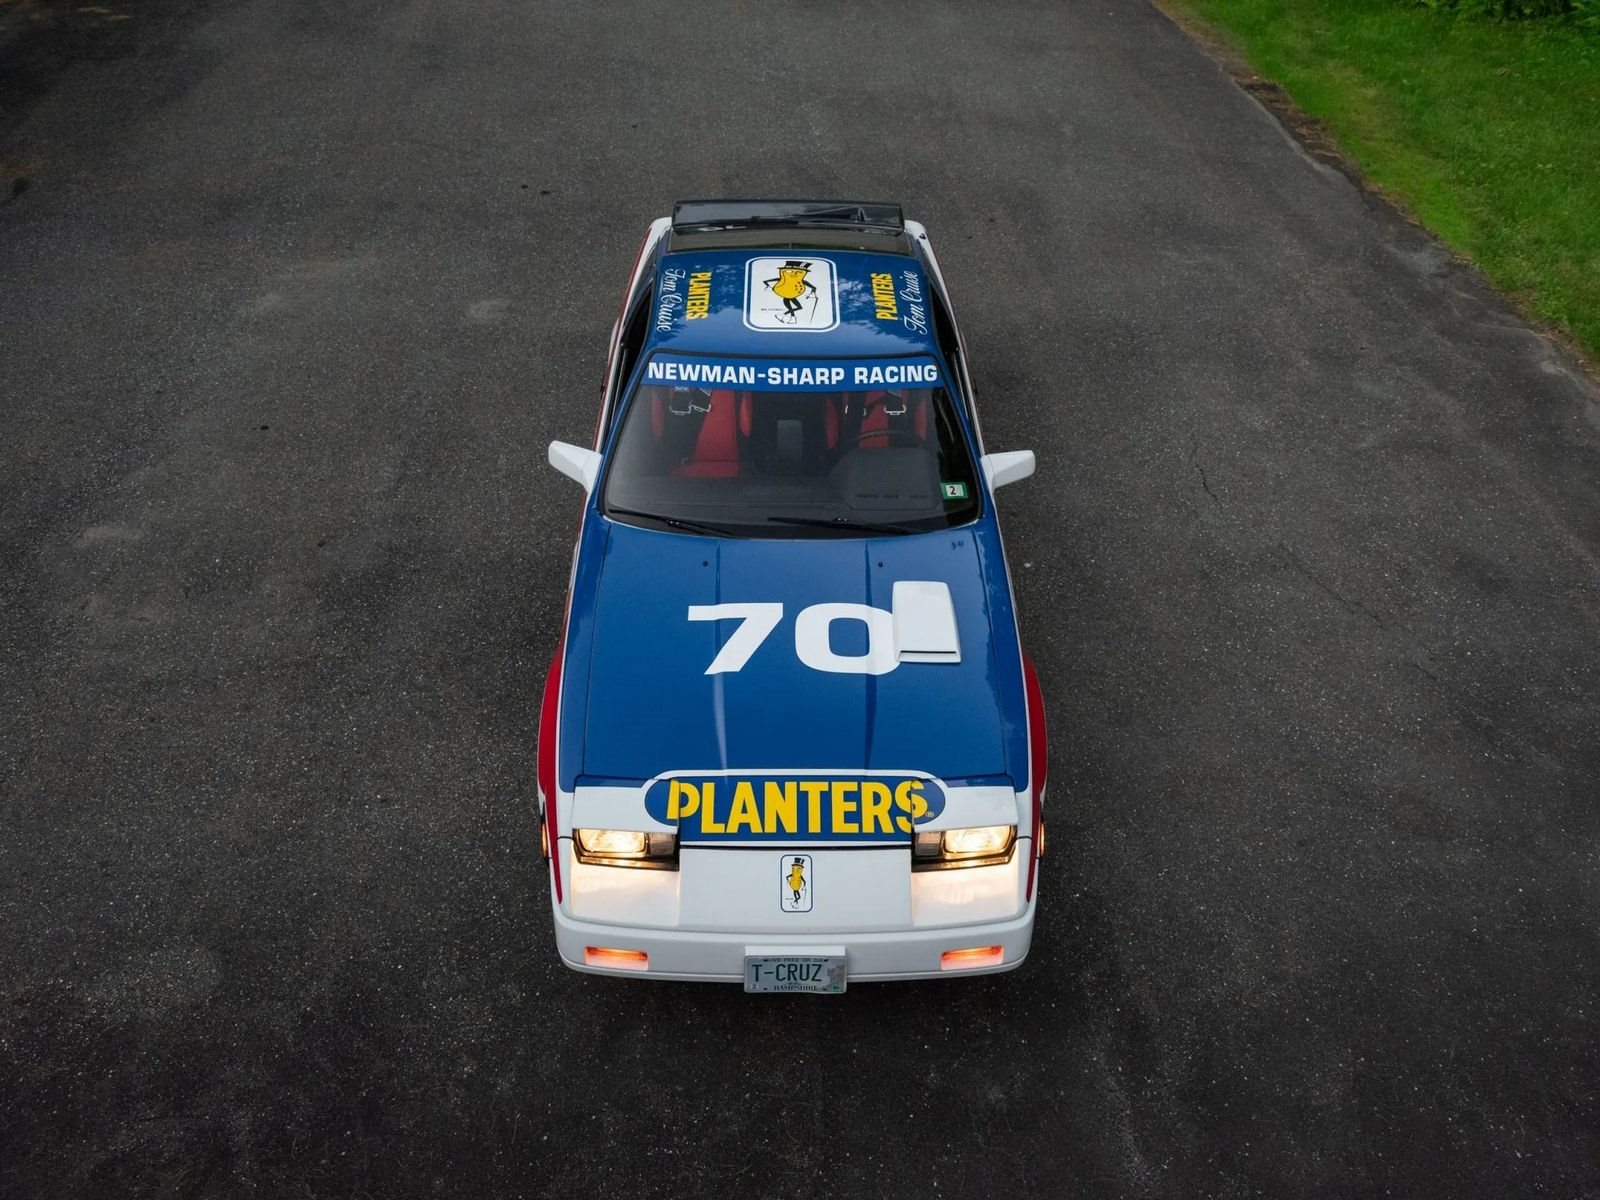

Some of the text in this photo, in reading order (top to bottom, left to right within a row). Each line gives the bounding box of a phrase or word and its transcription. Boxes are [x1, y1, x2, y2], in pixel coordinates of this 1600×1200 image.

[656, 268, 686, 332] Tom Cruise
[686, 271, 712, 321] PLANTERS
[870, 272, 898, 320] PLANTERS
[899, 270, 928, 335] Tom Cruise
[647, 362, 938, 386] NEWMAN-SHARP RACING
[949, 485, 957, 496] 2
[687, 602, 901, 675] 70
[666, 780, 929, 833] PLANTERS
[751, 963, 823, 982] T-CRUZ
